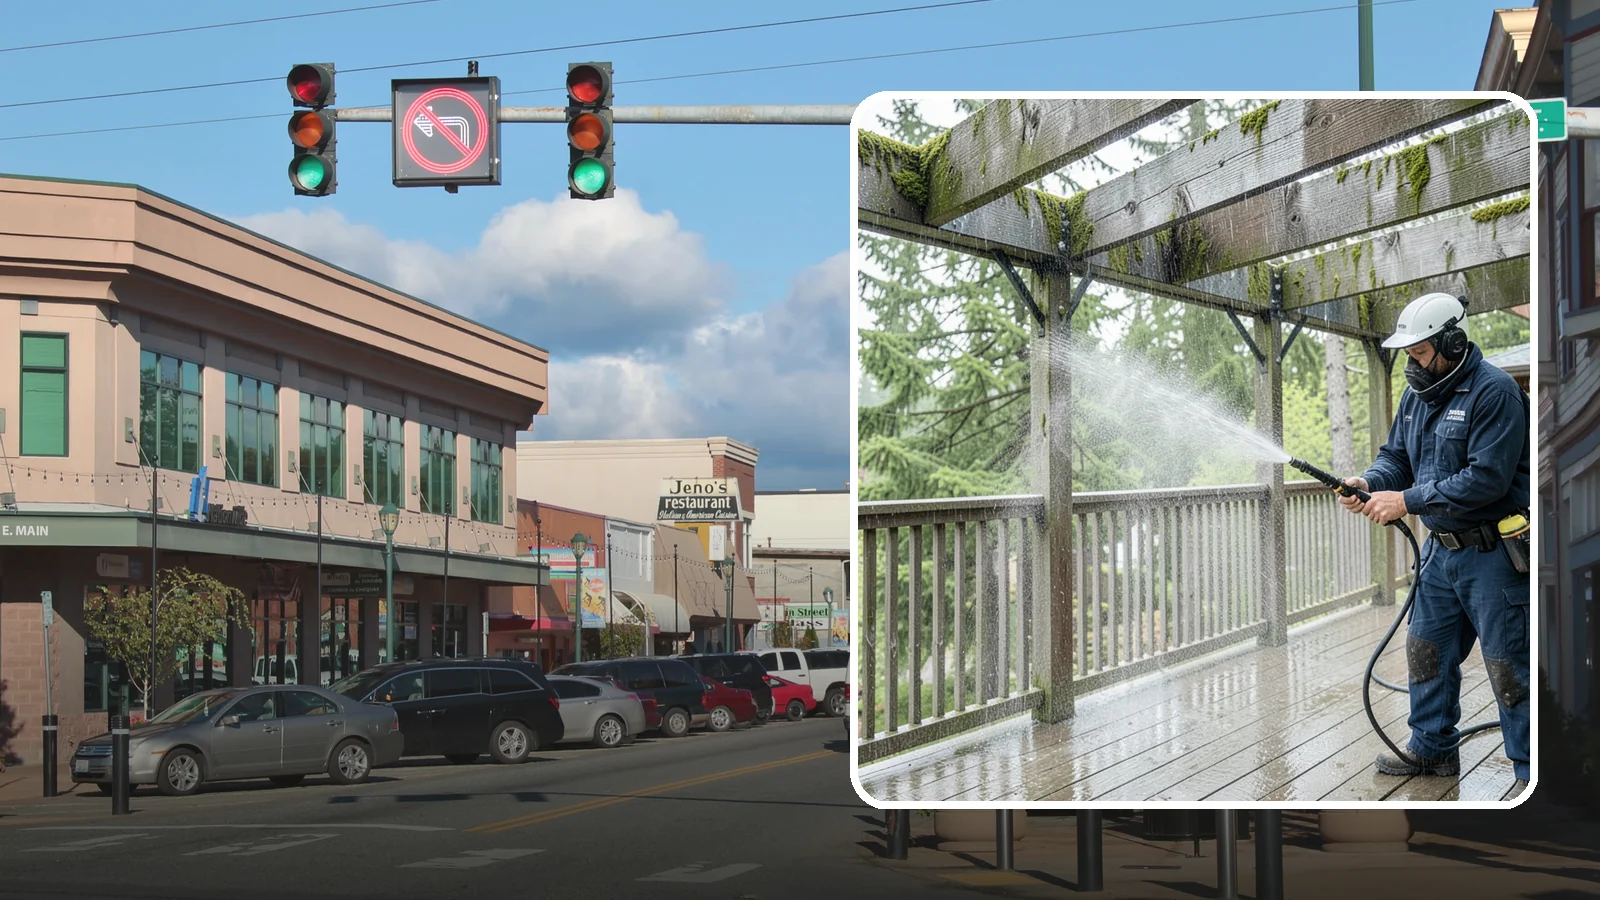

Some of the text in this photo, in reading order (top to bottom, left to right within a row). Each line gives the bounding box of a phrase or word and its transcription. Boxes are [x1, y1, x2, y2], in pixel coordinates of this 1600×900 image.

[670, 480, 727, 494] Jeno's
[665, 497, 730, 508] restaurant
[659, 510, 681, 519] Italian
[686, 510, 714, 519] American
[715, 509, 737, 519] Cuisine
[2, 526, 48, 536] E. MAIN
[798, 607, 828, 616] Street
